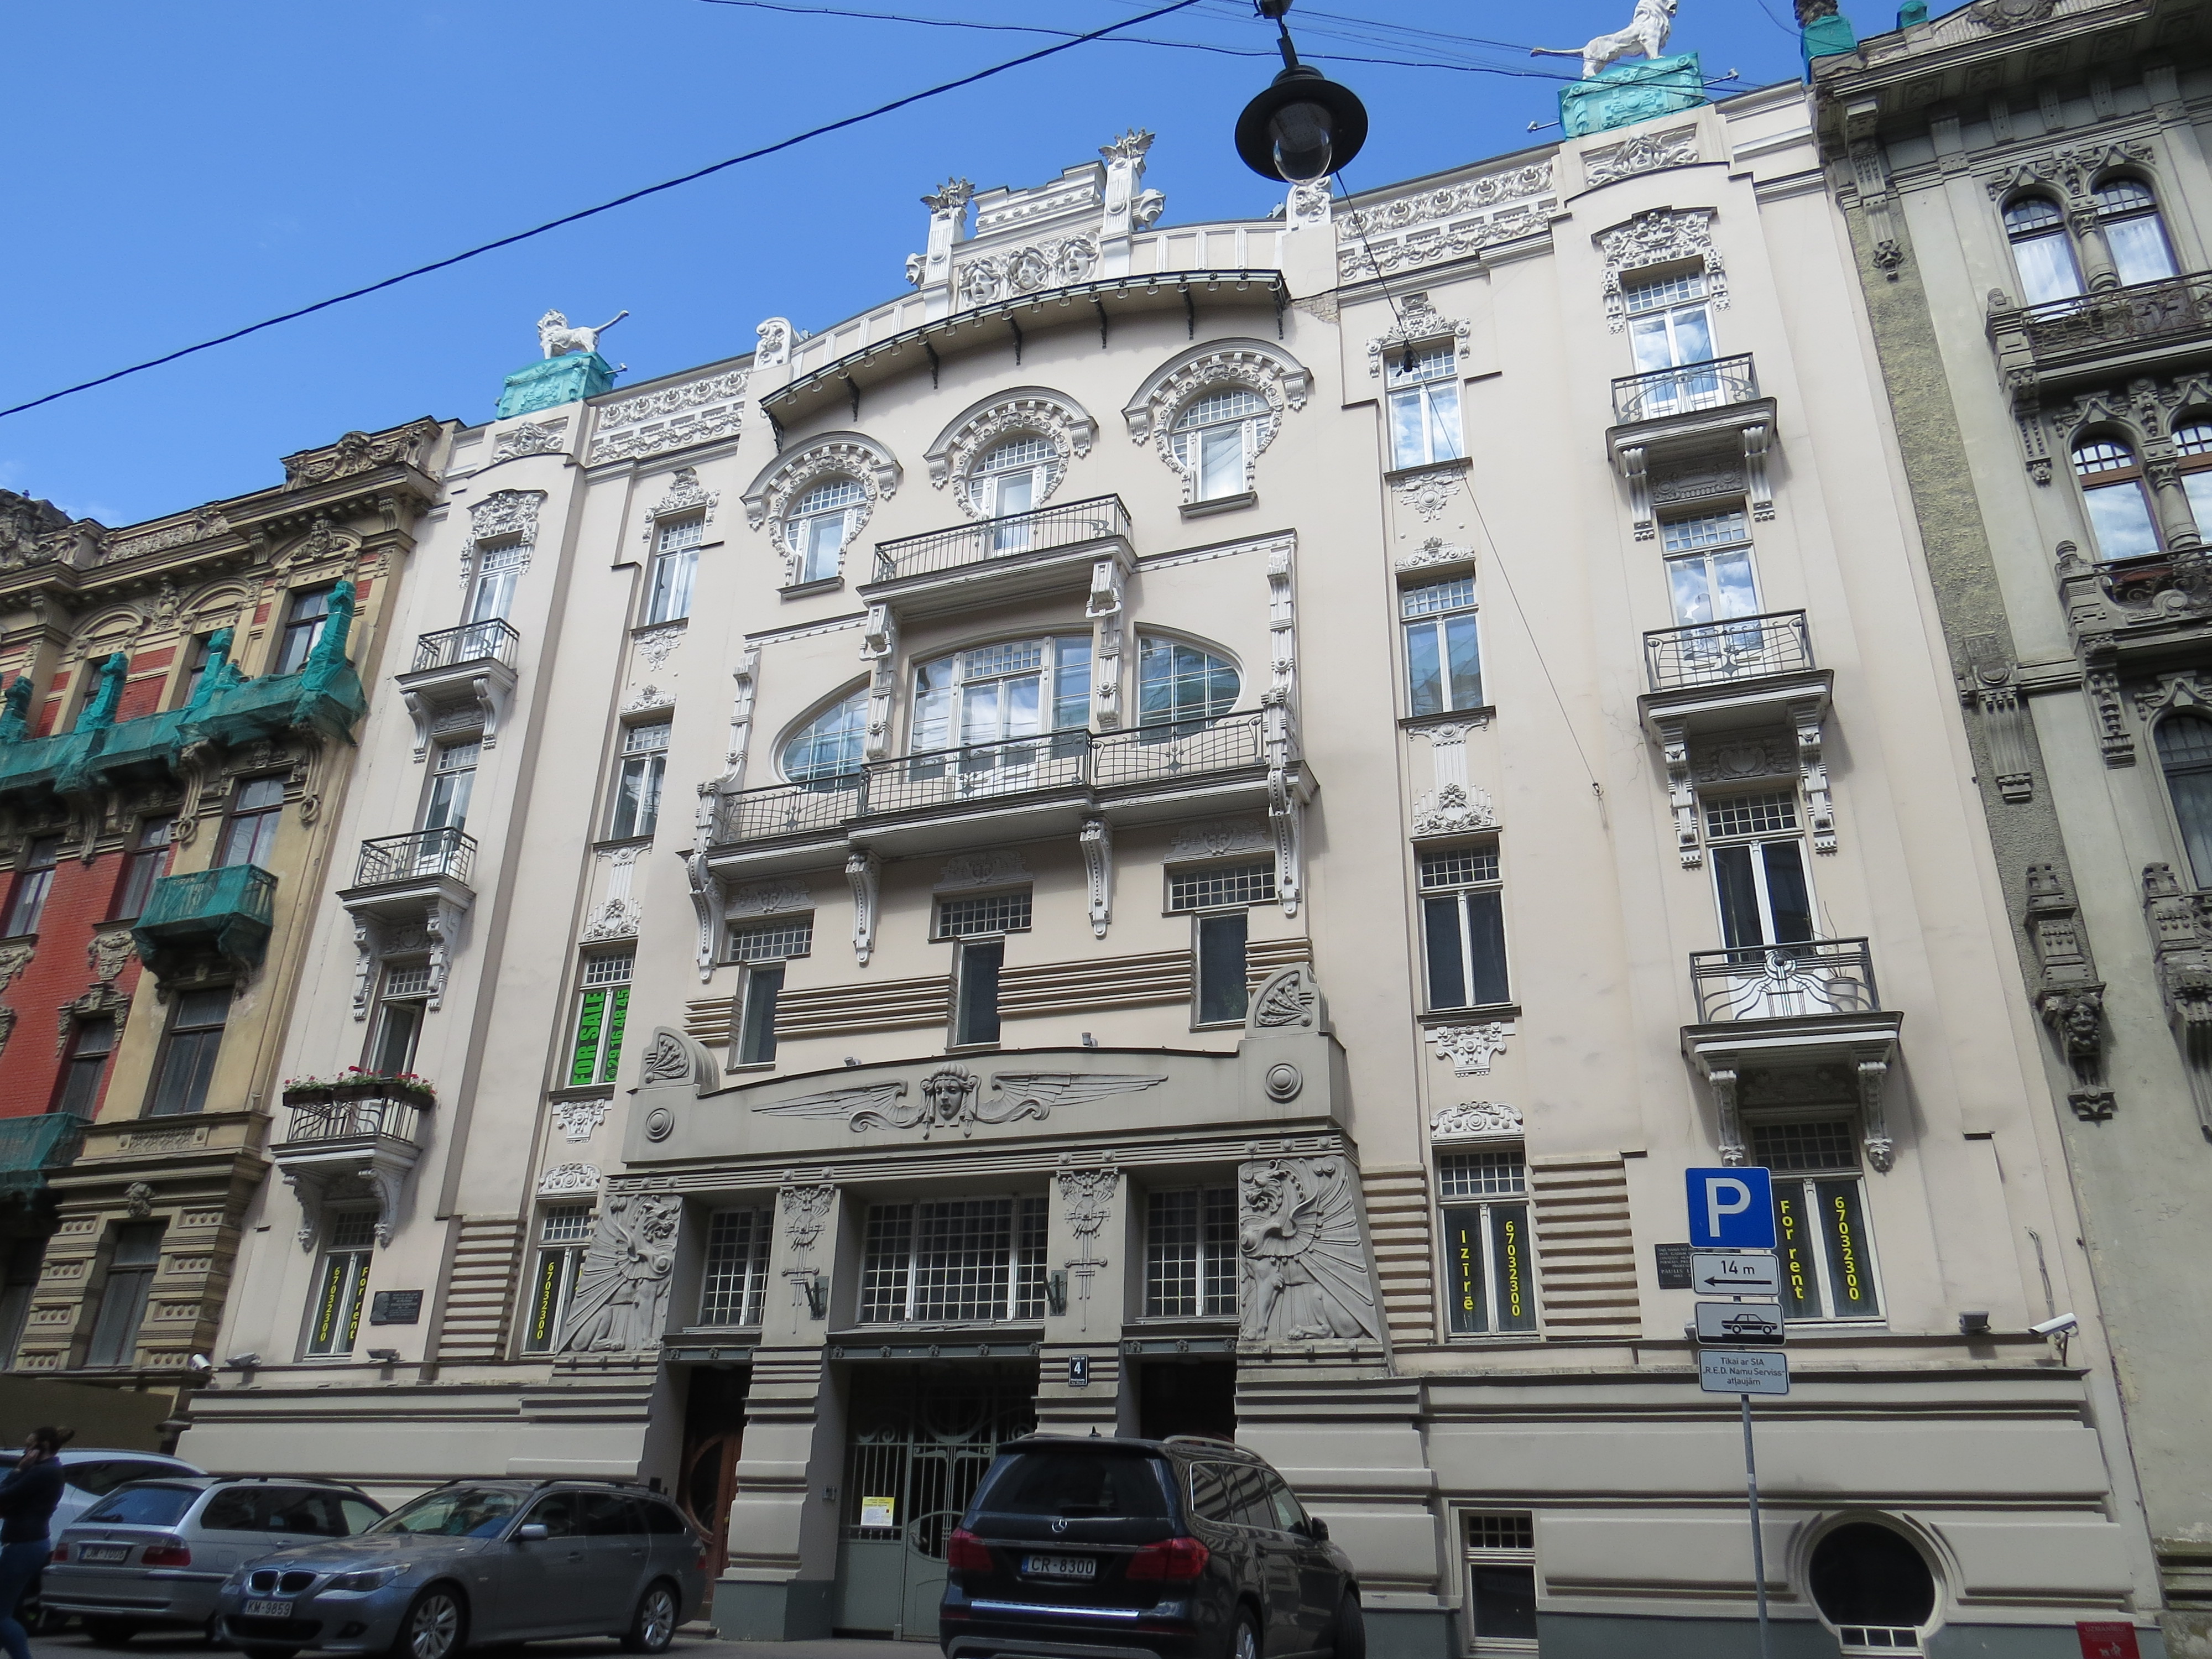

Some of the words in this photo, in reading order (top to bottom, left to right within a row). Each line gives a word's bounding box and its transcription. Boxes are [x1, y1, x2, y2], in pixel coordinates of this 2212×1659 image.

[578, 992, 605, 1041] SALE
[615, 989, 630, 1007] 45
[613, 1009, 627, 1027] 48
[607, 1049, 620, 1067] 29
[610, 1030, 623, 1047] 16
[572, 1045, 597, 1084] FOR
[1705, 1178, 1751, 1237] P
[1721, 1260, 1738, 1274] 14
[1780, 1200, 1794, 1240] For
[1788, 1248, 1804, 1300] rent
[1834, 1196, 1860, 1300] 67032300
[358, 1267, 369, 1296] For
[1460, 1230, 1474, 1311] Izīrē
[1505, 1220, 1521, 1317] 67032300
[319, 1266, 341, 1342] 67032300
[536, 1262, 555, 1339] 67032300
[349, 1302, 361, 1339] rent
[1074, 1361, 1081, 1374] 4
